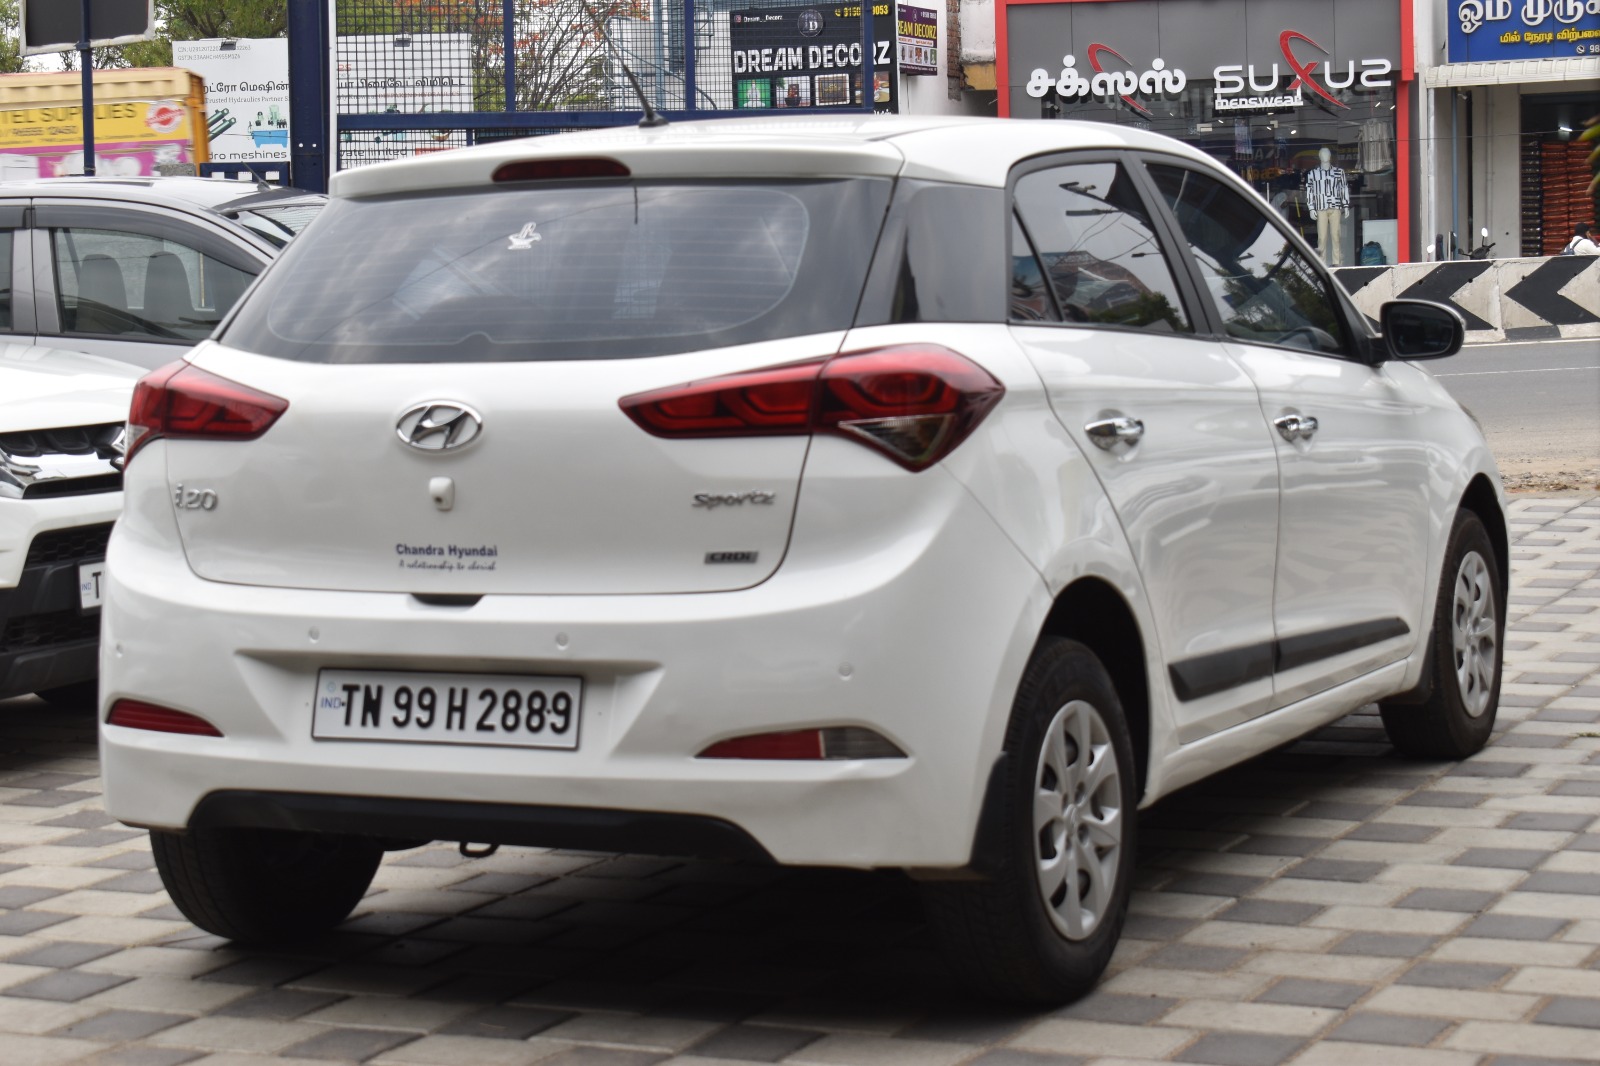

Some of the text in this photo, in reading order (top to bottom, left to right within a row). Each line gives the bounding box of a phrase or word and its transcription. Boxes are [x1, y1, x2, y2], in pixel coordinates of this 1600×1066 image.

[733, 40, 891, 73] DREAM DECOZ
[40, 103, 137, 122] SUPLIES
[229, 150, 287, 160] meshines
[175, 483, 218, 511] i20
[396, 544, 498, 559] Chandra Hyundai
[321, 696, 341, 709] IND
